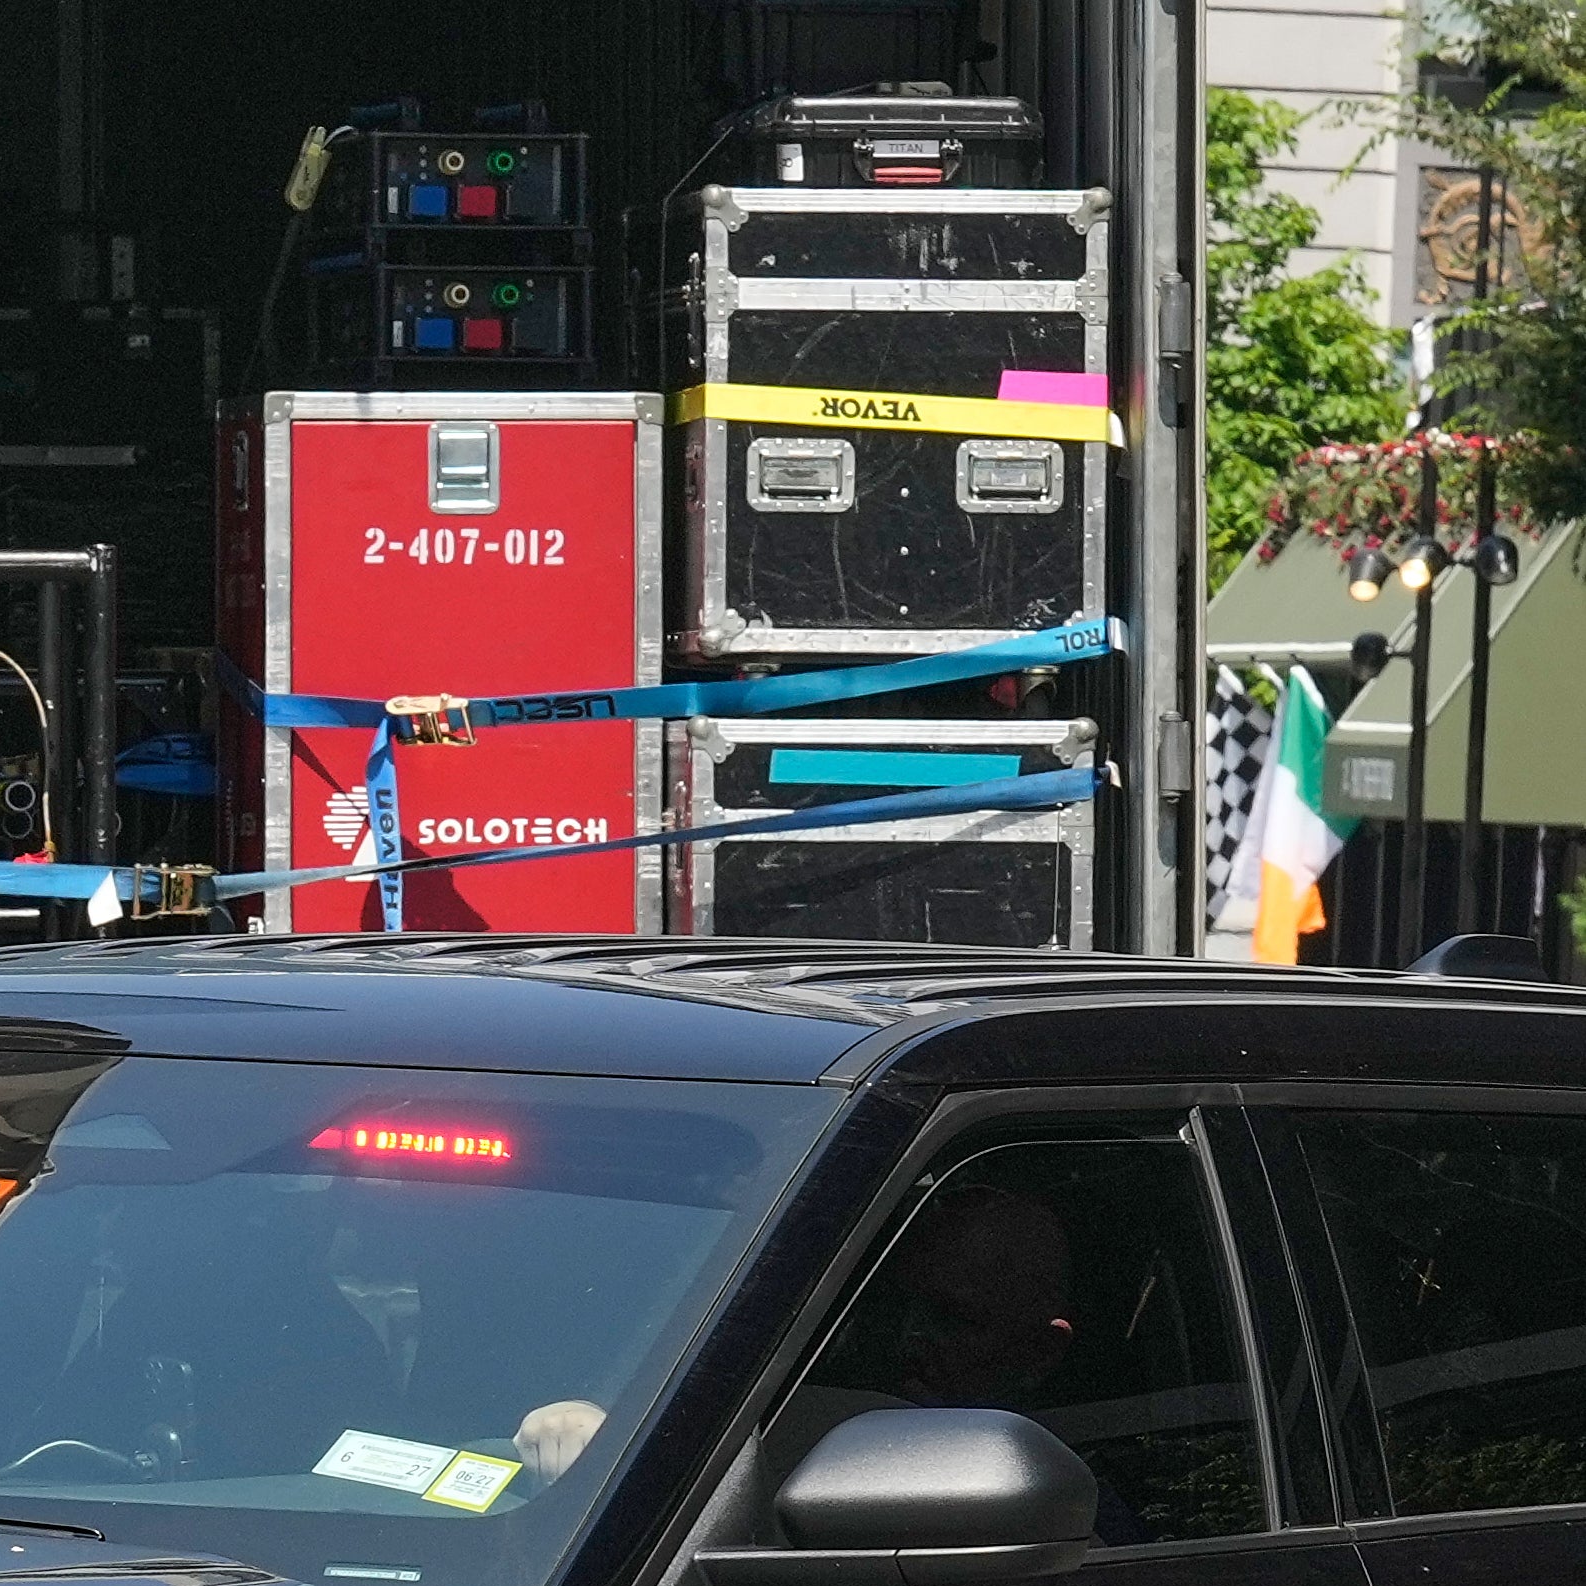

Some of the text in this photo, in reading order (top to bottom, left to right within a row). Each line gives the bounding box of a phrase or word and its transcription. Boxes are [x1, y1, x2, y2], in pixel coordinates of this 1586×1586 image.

[889, 143, 923, 154] TITAN
[820, 397, 922, 422] VEVOR
[364, 527, 565, 566] 2-407-012
[418, 817, 608, 844] SOLOTECH
[340, 1451, 355, 1463] 6
[405, 1464, 432, 1478] 27
[455, 1470, 496, 1486] 06 27
